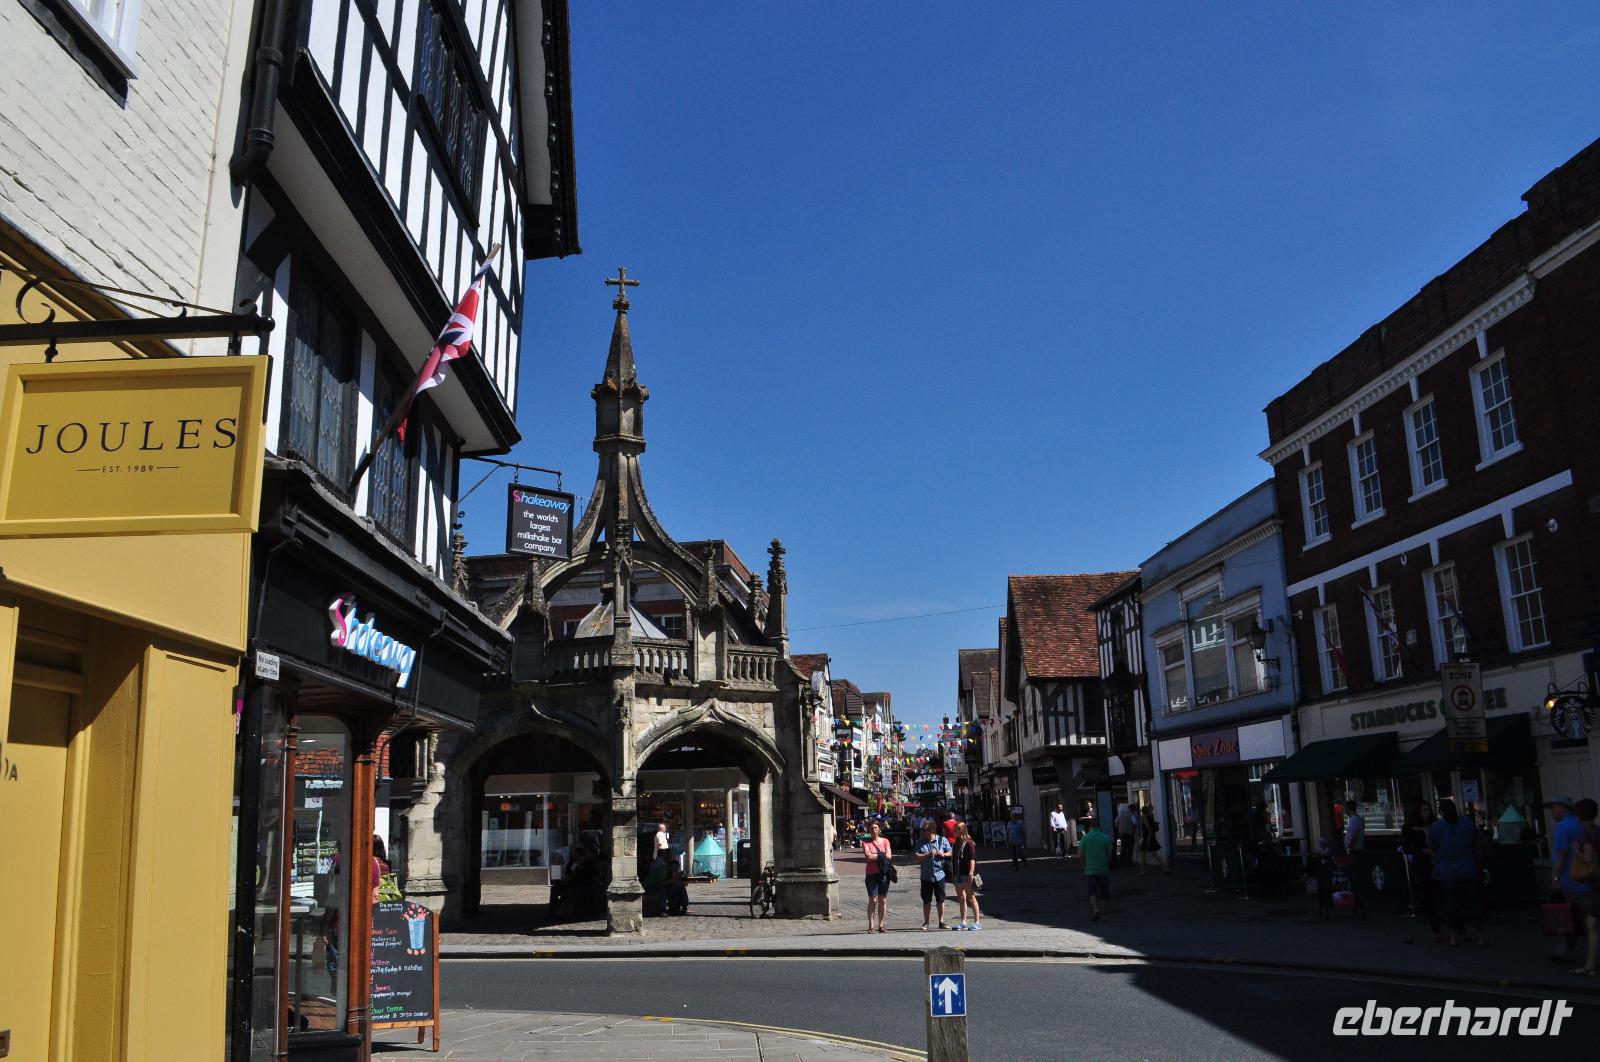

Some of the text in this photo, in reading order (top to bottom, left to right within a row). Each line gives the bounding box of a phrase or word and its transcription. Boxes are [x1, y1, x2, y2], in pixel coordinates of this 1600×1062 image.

[25, 417, 237, 454] JOULES
[102, 464, 154, 473] EST. 1989
[513, 489, 571, 514] Shakeaway
[523, 510, 535, 519] the
[529, 521, 551, 532] largest
[517, 531, 562, 545] milkshake bar
[524, 542, 556, 554] company
[329, 597, 416, 689] Shakeaway
[1448, 671, 1473, 681] ZONE
[1350, 699, 1437, 731] STARBUCKS
[1192, 737, 1237, 758] Shoe Zone
